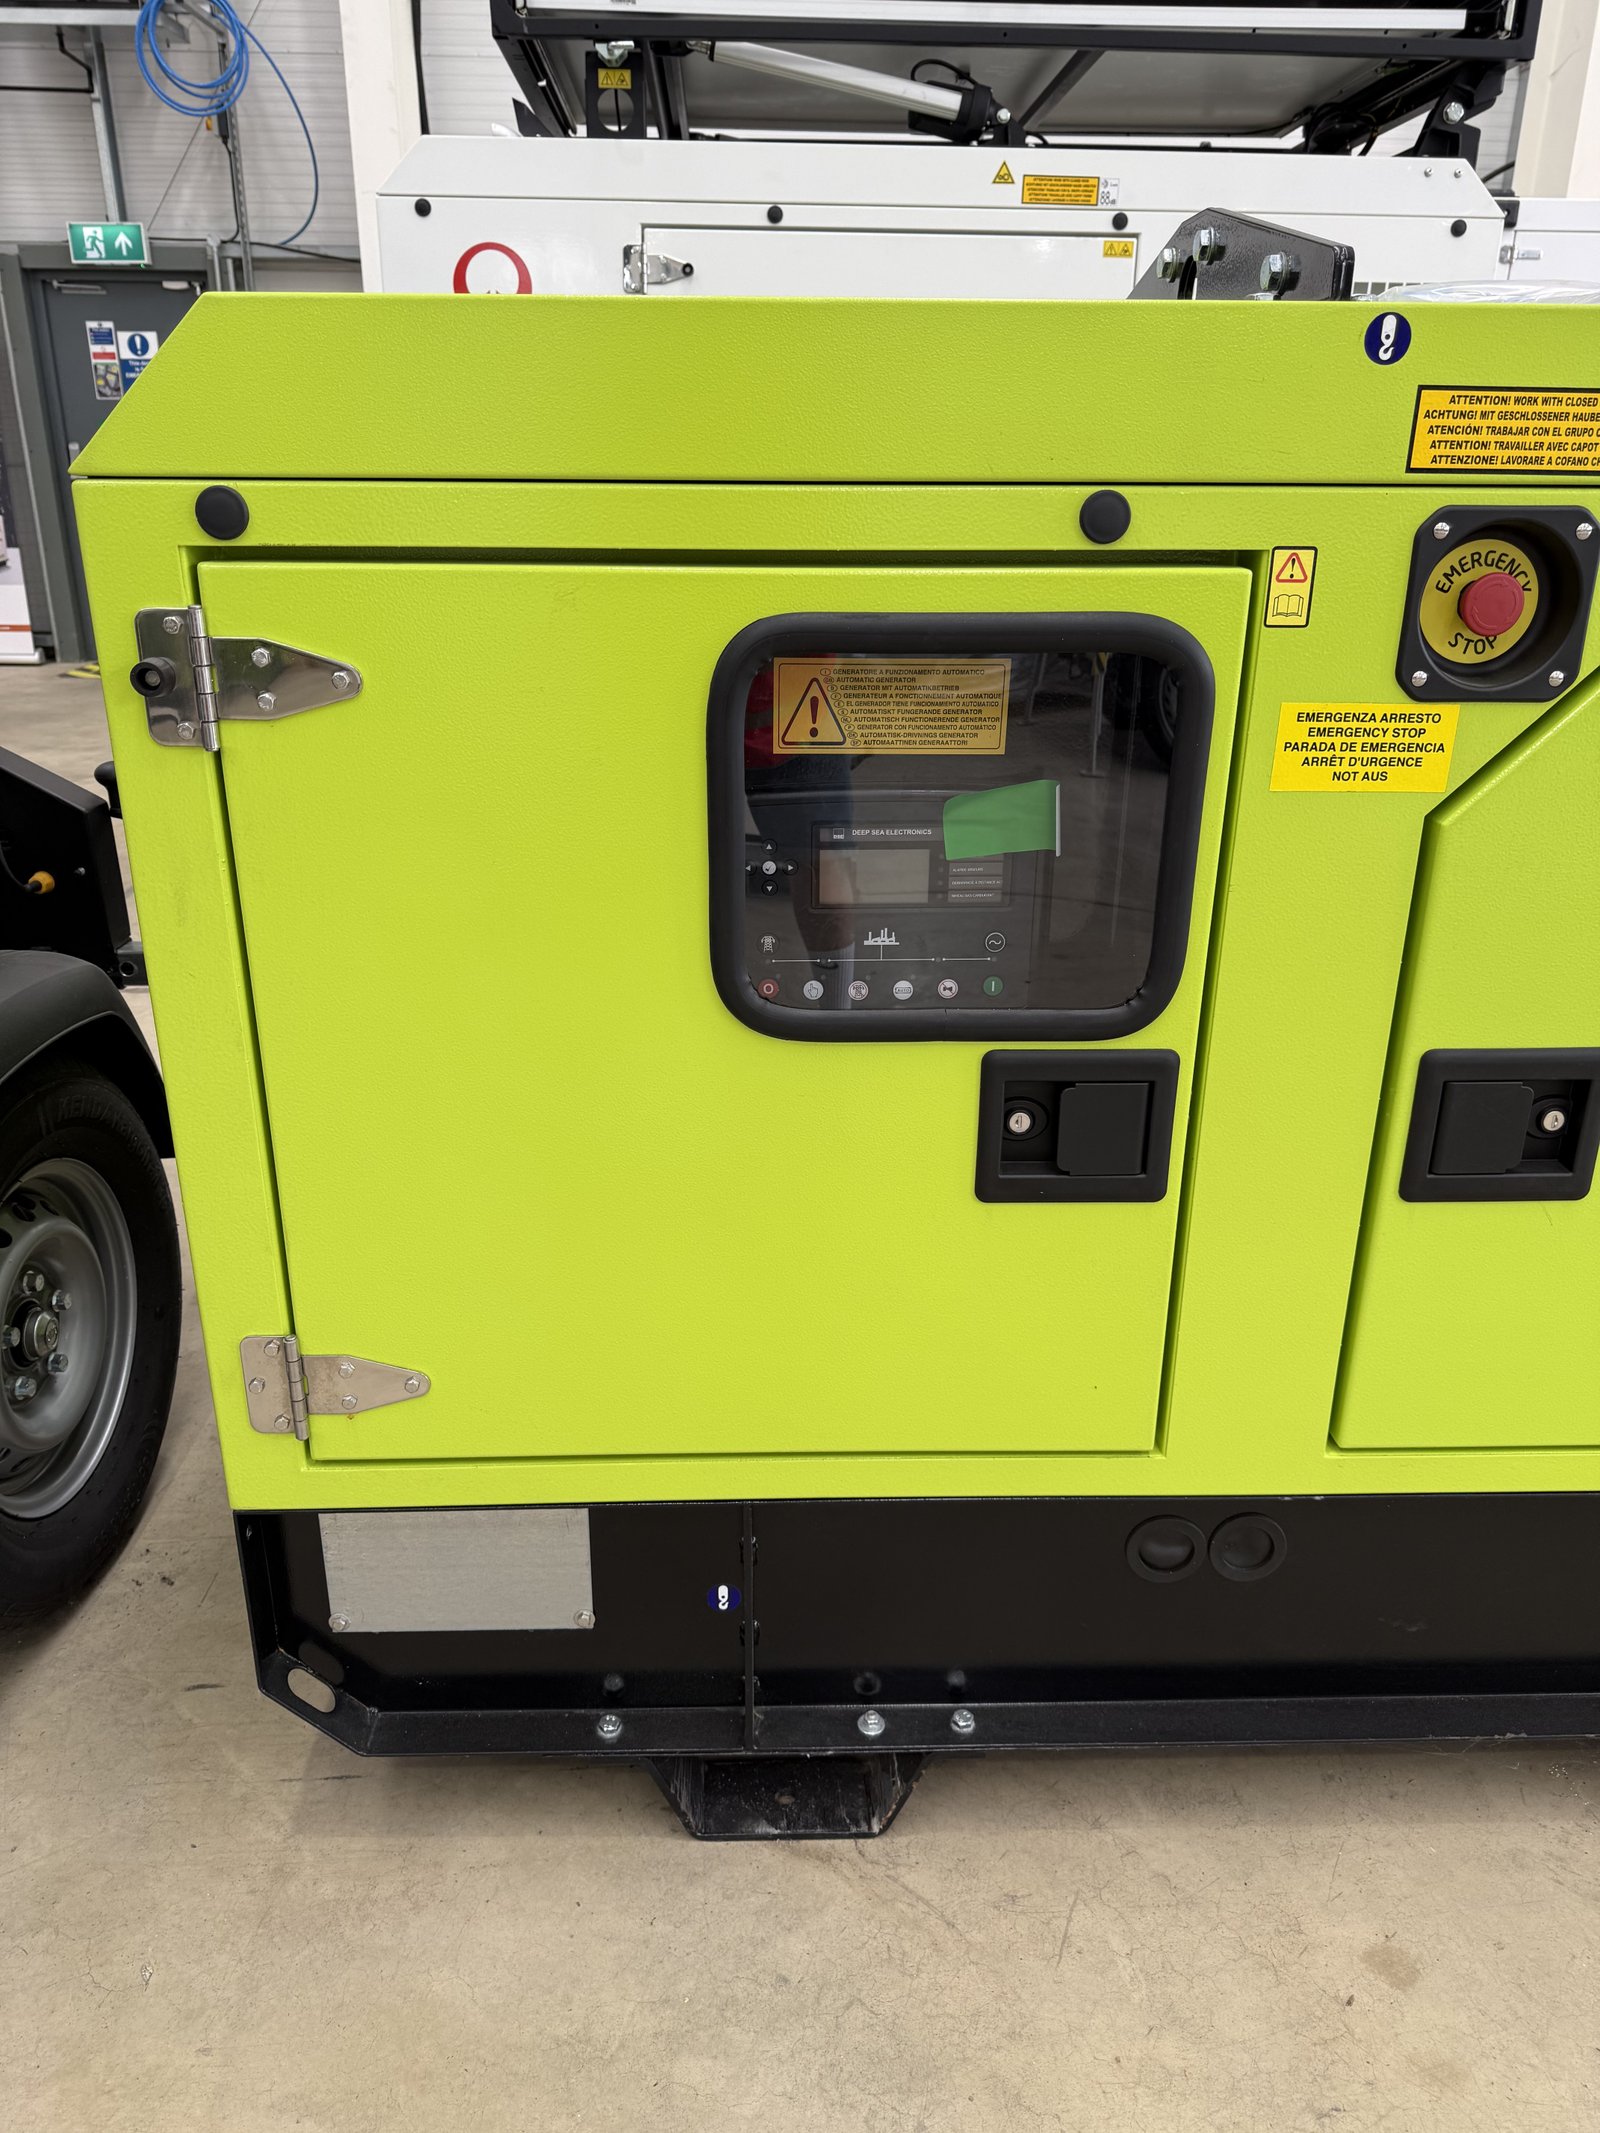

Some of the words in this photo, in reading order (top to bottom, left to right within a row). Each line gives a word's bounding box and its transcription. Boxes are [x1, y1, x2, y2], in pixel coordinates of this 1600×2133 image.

[1449, 395, 1511, 406] ATTENTION!
[1513, 396, 1539, 406] WORK
[1541, 396, 1563, 406] WITH
[1565, 397, 1598, 407] CLOSED
[1424, 410, 1478, 420] ACHTUNG!
[1480, 410, 1495, 420] MIT
[1497, 411, 1570, 421] GESCHLOSSENER
[1427, 423, 1483, 435] ATENCIÓN!
[1486, 426, 1530, 436] TRABAJAR
[1532, 427, 1550, 437] CON
[1552, 427, 1563, 437] EL
[1565, 428, 1594, 437] GRUPO
[1430, 440, 1491, 450] ATTENTION!
[1493, 441, 1544, 451] TRAVAILLER
[1546, 442, 1569, 451] AVEC
[1570, 442, 1600, 452] CAPOT
[1430, 455, 1499, 465] ATTENZIONE!
[1501, 456, 1545, 466] LAVORARE
[1546, 456, 1553, 466] A
[1555, 456, 1588, 466] COFANO
[1296, 712, 1377, 722] EMERGENZA
[1380, 713, 1442, 723] ARRESTO
[1308, 727, 1388, 738] EMERGENCY
[1392, 728, 1426, 738] STOP
[1284, 742, 1336, 752] PARADA
[1340, 742, 1357, 752] DE
[1360, 743, 1445, 753] EMERGENCIA
[1301, 754, 1346, 766] ARRÊT
[1348, 757, 1423, 767] D'URGENCE
[1332, 771, 1359, 781] NOT
[1361, 771, 1388, 781] AUS
